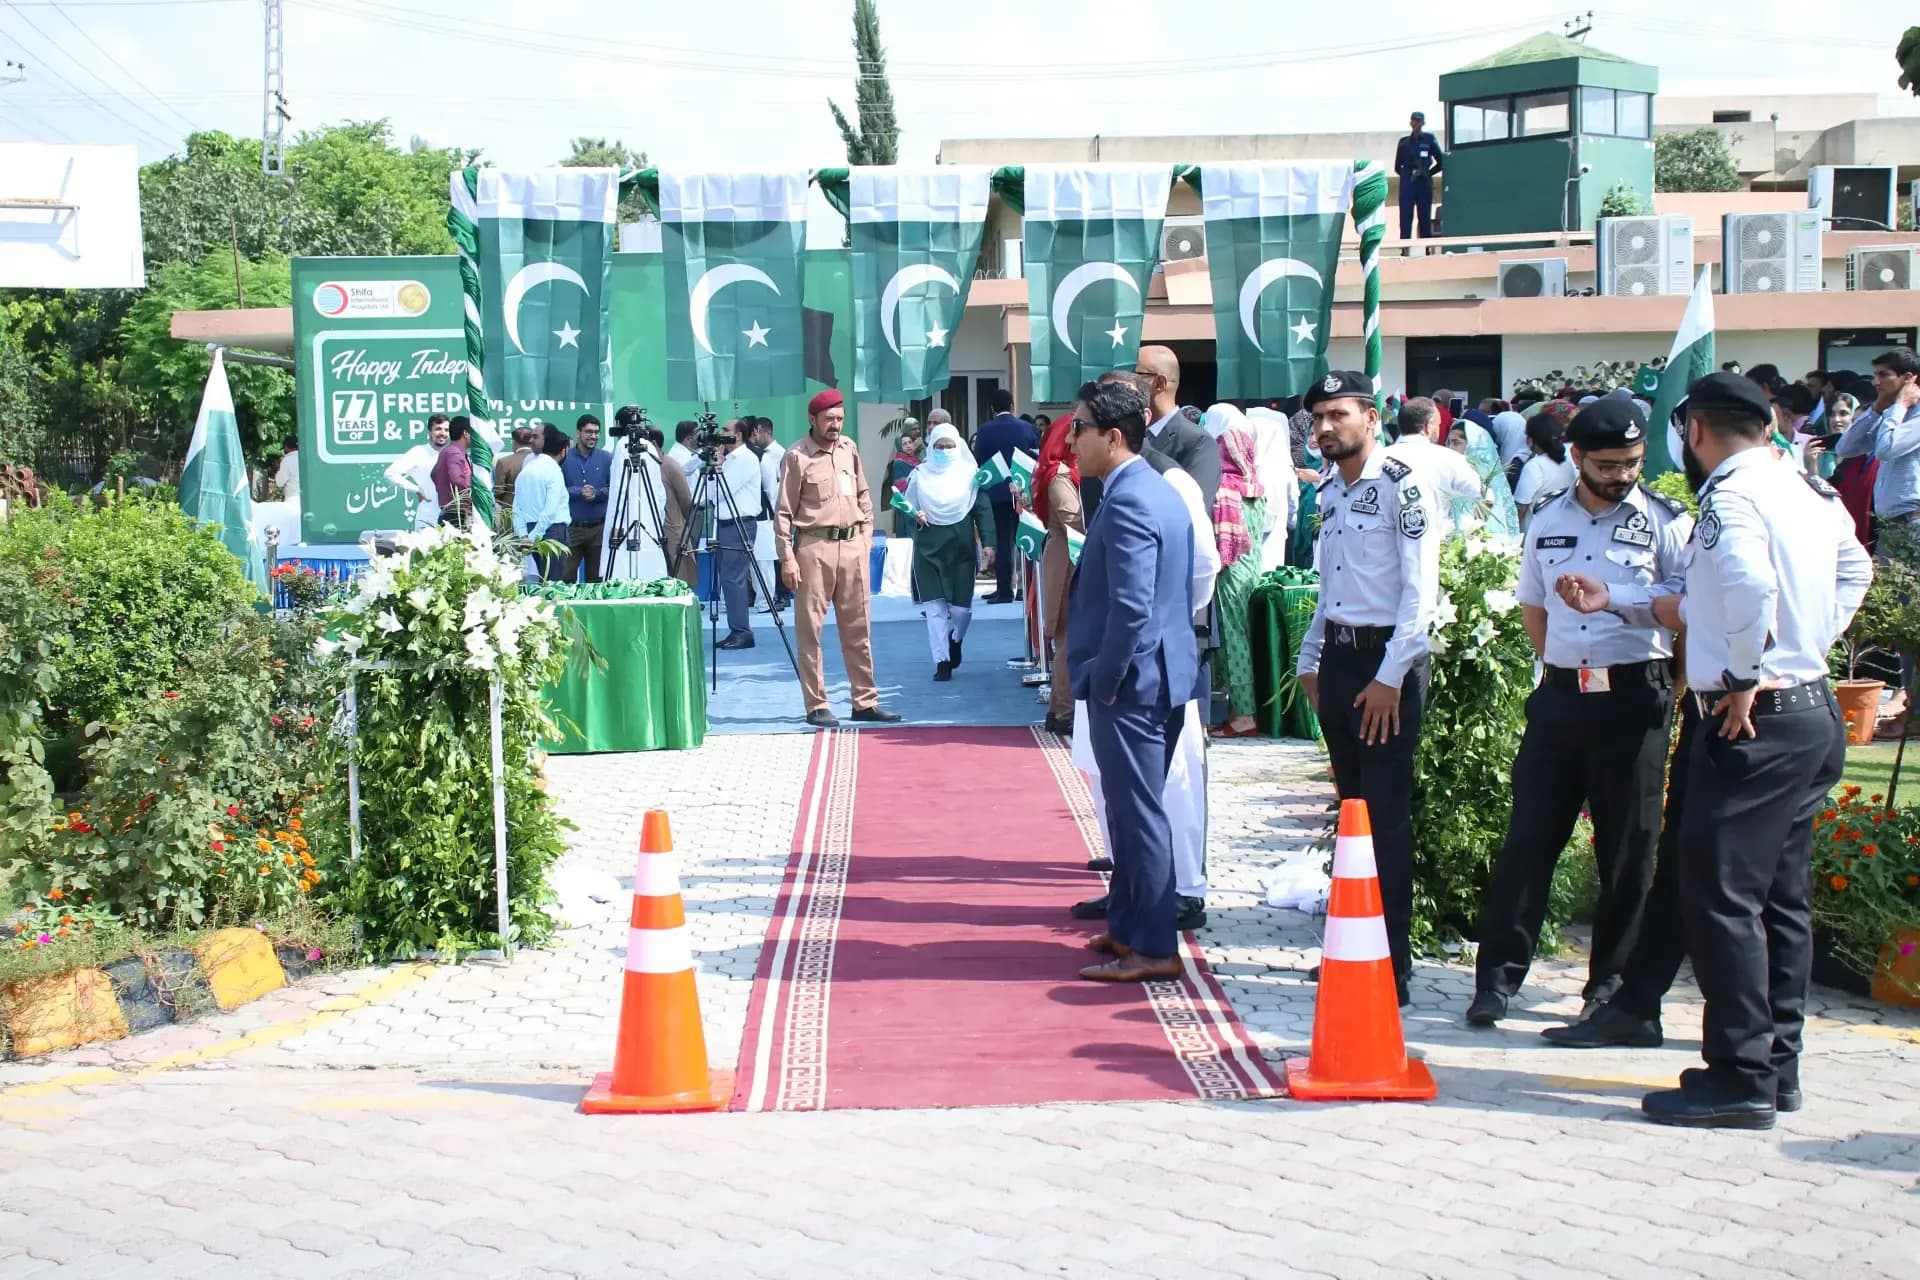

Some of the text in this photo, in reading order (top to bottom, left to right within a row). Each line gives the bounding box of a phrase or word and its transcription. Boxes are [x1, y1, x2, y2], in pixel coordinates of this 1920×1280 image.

[351, 287, 373, 297] Shifa
[331, 349, 468, 385] Happy Indep
[335, 394, 375, 418] 77
[383, 392, 513, 416] FREEDM,
[337, 420, 375, 430] YEARS
[383, 420, 402, 440] &
[349, 432, 364, 440] OF
[1543, 538, 1566, 546] NADIR
